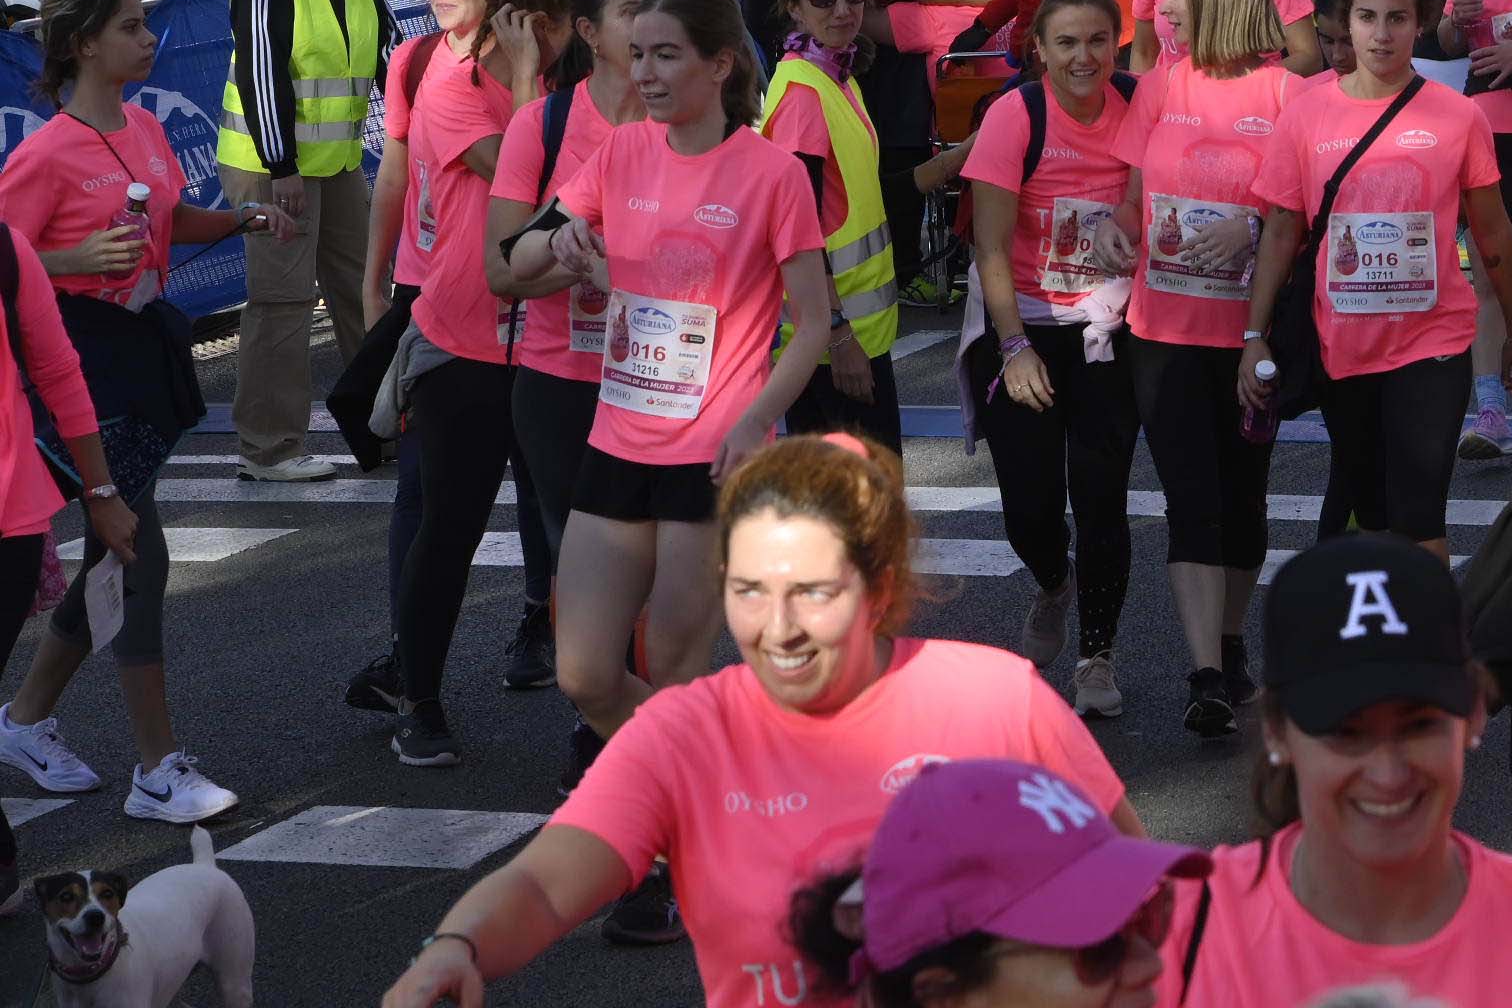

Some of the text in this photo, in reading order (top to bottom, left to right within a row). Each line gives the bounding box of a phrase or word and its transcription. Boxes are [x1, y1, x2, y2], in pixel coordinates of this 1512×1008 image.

[82, 170, 126, 192] OYSHO
[1359, 230, 1400, 240] ASTURIANA
[1361, 252, 1399, 267] 016
[1156, 275, 1188, 288] OYSHO
[1365, 271, 1394, 281] 13711
[1336, 296, 1429, 306] OYSHO Santander
[632, 314, 675, 331] ASTURIANA
[681, 318, 707, 328] SUMA
[580, 336, 604, 346] OYS
[630, 340, 667, 362] 016
[632, 362, 660, 377] 31216
[632, 377, 641, 386] DE
[640, 379, 650, 388] LA
[649, 381, 676, 392] MUJER
[606, 386, 694, 410] OYSHO Santander
[1339, 570, 1409, 640] A
[741, 959, 808, 1008] TU
